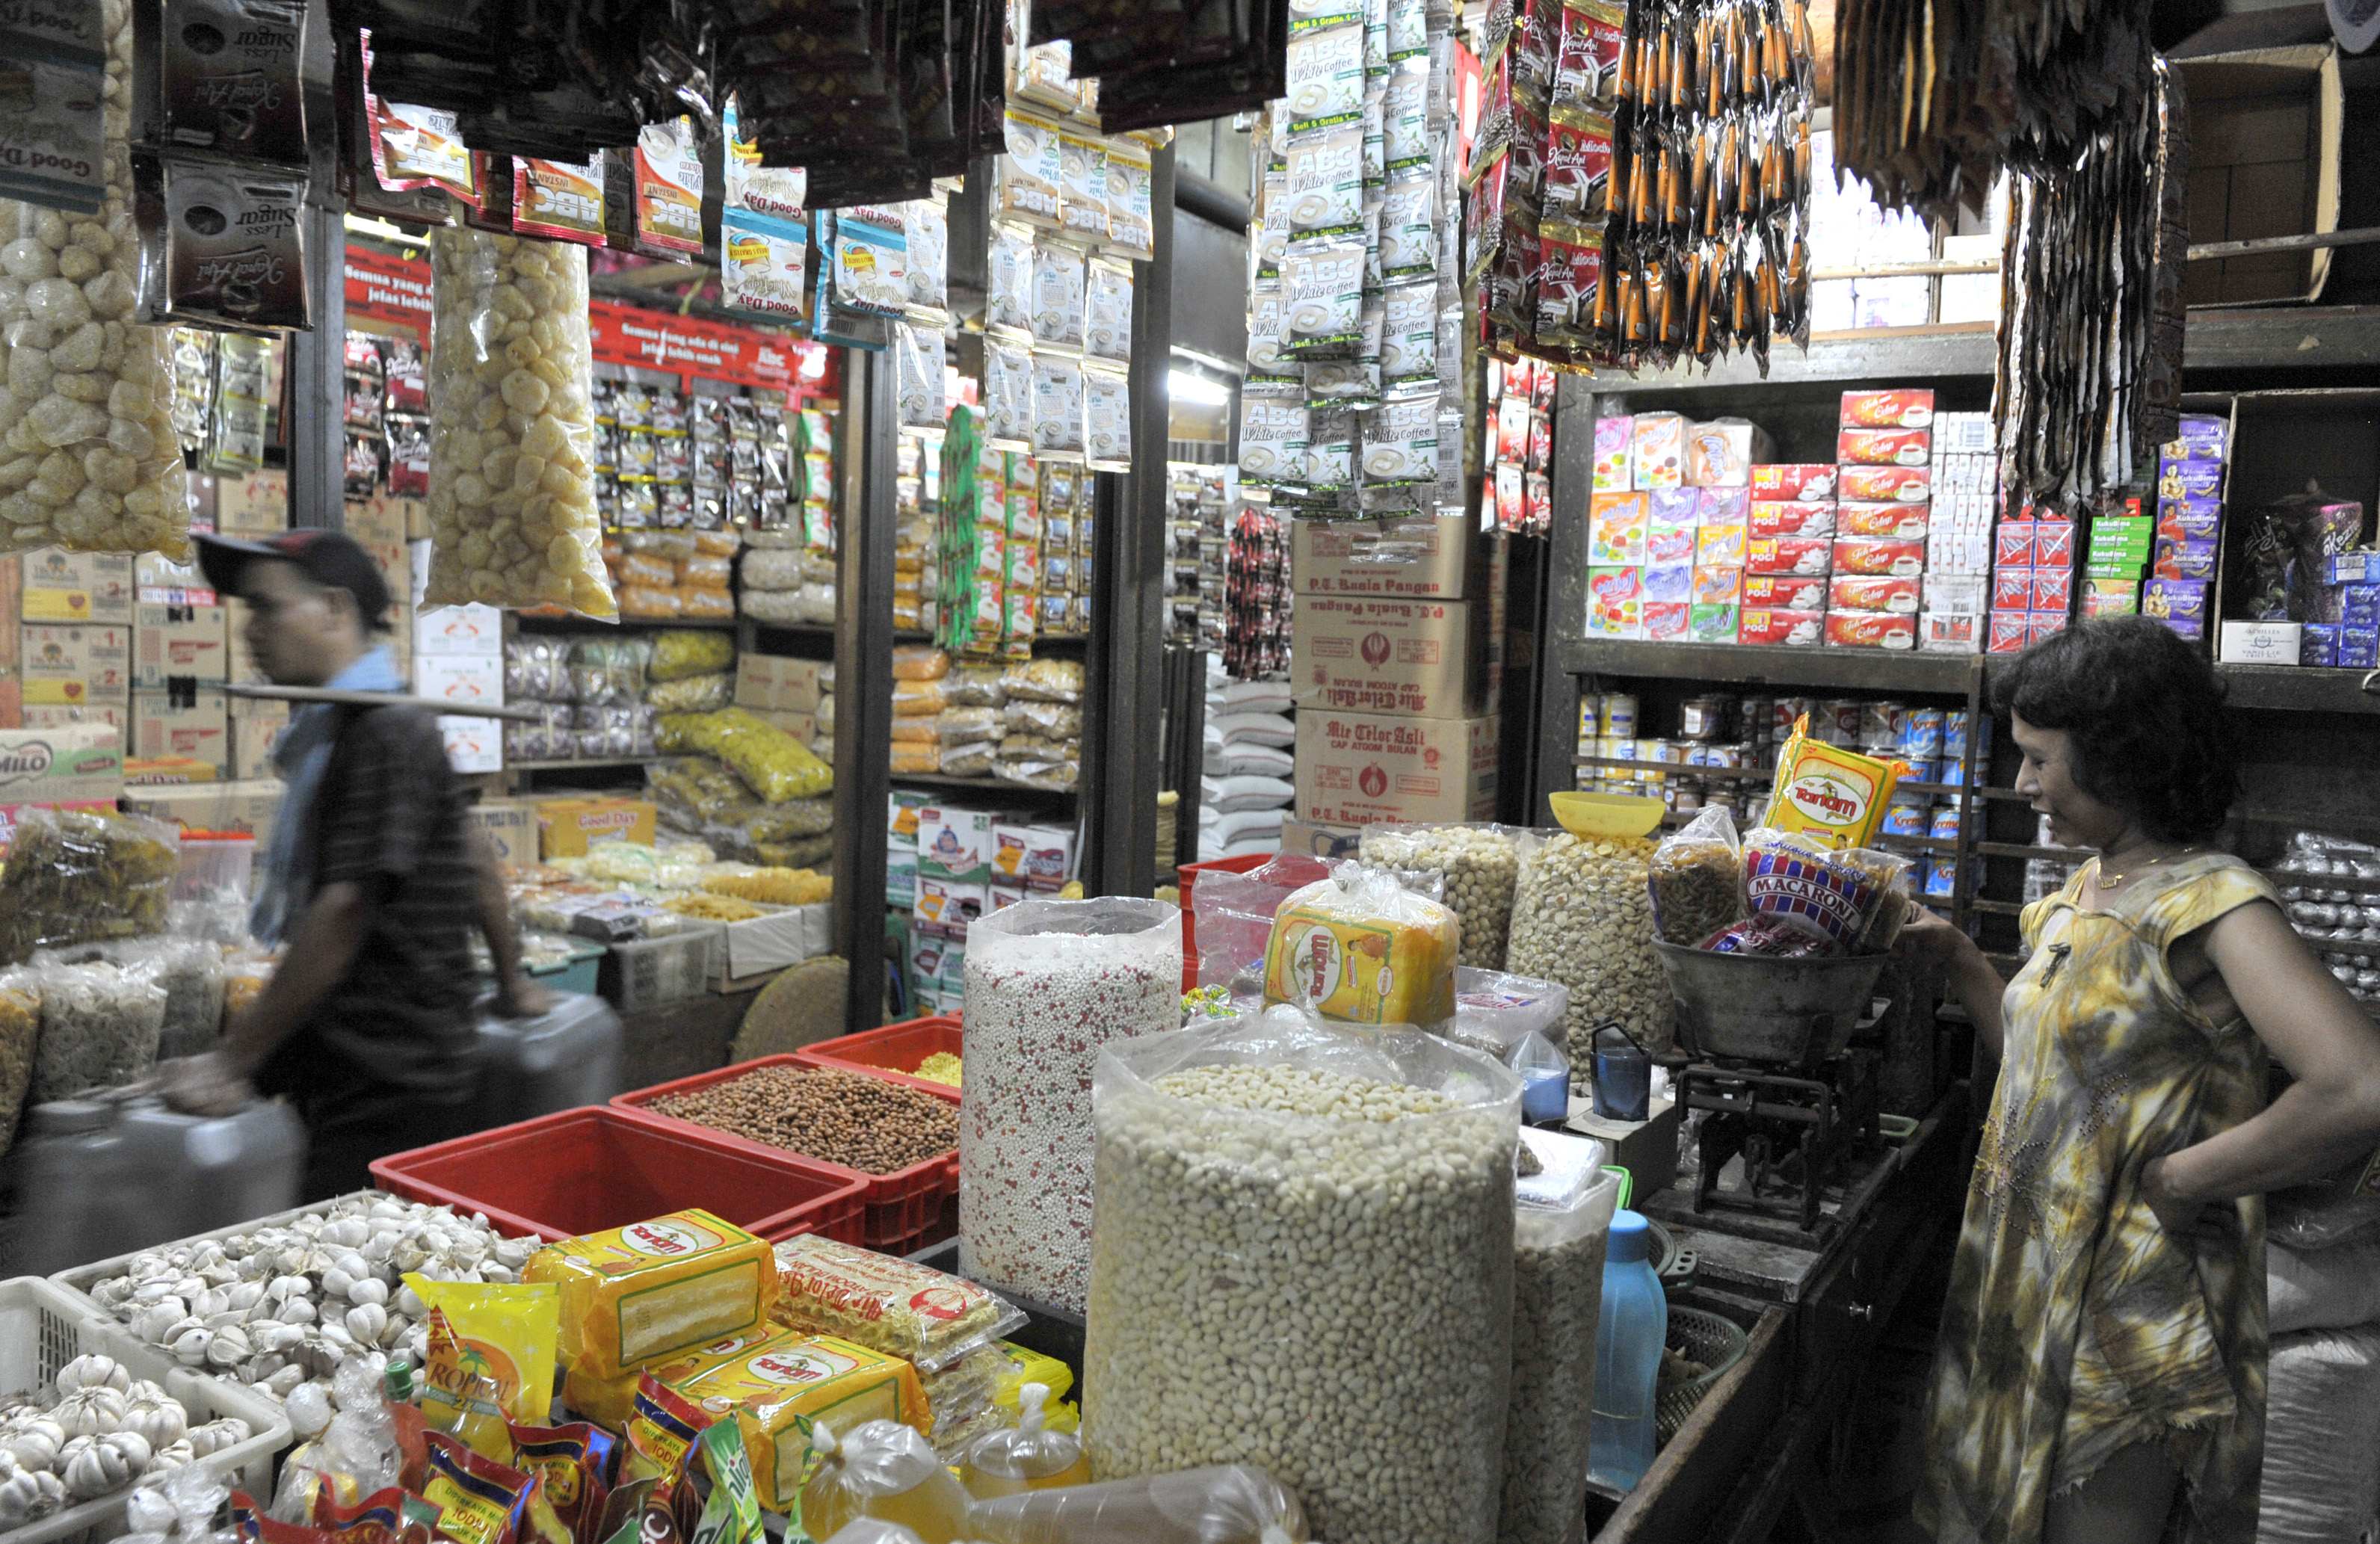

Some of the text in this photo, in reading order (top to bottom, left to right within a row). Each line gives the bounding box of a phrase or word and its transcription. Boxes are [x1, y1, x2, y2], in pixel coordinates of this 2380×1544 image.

[1293, 14, 1344, 30] Beli Gratis
[234, 25, 296, 52] Sugar
[1583, 38, 1598, 53] Api
[242, 48, 280, 64] Less
[1293, 33, 1355, 67] ABC
[1290, 62, 1324, 84] White
[1324, 57, 1354, 74] Coffee
[1293, 116, 1344, 132] Beli Gratis
[31, 150, 91, 178] Good
[1295, 145, 1354, 176] ABC
[1387, 158, 1411, 170] Gratis
[1570, 153, 1586, 167] Api
[531, 172, 569, 188] INSTANT
[1011, 177, 1037, 188] INSTANT
[1290, 168, 1353, 194] White Coffee
[647, 184, 679, 200] INSTANT
[1013, 187, 1058, 211] ABC
[534, 185, 602, 223] ABC
[742, 191, 802, 219] Good Day
[234, 204, 296, 226] Sugar
[650, 198, 701, 231] ABC
[853, 206, 902, 229] Good Day
[1065, 206, 1109, 231] ABC
[244, 224, 281, 238] Less
[1111, 223, 1150, 246] ABC
[1293, 226, 1344, 240] Beli Gratis
[1295, 258, 1354, 285] ABC
[1560, 265, 1576, 281] Api
[345, 264, 424, 297] Semua yang
[368, 285, 398, 305] jelas
[1289, 279, 1355, 302] White Coffee
[736, 293, 799, 316] Good Day
[852, 297, 904, 318] Good Day
[621, 322, 660, 340] Semua
[1396, 319, 1428, 335] Coffee
[1251, 374, 1266, 383] Beli
[1860, 395, 1878, 411] Teh
[1874, 402, 1899, 419] Celup
[1246, 404, 1303, 426] ABC
[1366, 406, 1431, 427] ABC
[1242, 427, 1303, 442] White Coffee
[1318, 433, 1345, 444] Coffee
[1364, 427, 1431, 445] White Coffee
[1857, 434, 1874, 449] Teh
[2180, 434, 2222, 442] KukuBima
[1869, 439, 1895, 457] Celup
[1754, 481, 1781, 490] POCI
[1858, 472, 1875, 487] Teh
[1869, 477, 1896, 494] Celup
[1753, 516, 1780, 526] POCI
[1855, 510, 1873, 525] Teh
[1869, 514, 1893, 531] Celup
[1750, 552, 1776, 562] POCI
[1851, 546, 1869, 561] Teh
[1863, 551, 1890, 568] Celup
[1385, 578, 1440, 594] Pangan
[1746, 588, 1772, 598] POCI
[1847, 583, 1865, 596] Teh
[1860, 587, 1886, 603] Celup
[2162, 594, 2203, 602] KukuBima
[1743, 623, 1769, 633] POCI
[1843, 618, 1860, 632] Teh
[1855, 625, 1881, 639] Celup
[1333, 678, 1420, 693] CAP ATOOM BULAN
[1325, 720, 1426, 746] Mie Telor Asli
[1331, 740, 1418, 756] CAP ATOOM BULAN
[1794, 785, 1857, 818] Tanam
[1893, 815, 1926, 827] Krem
[1937, 867, 1955, 879] Kre
[1755, 878, 1857, 923] MACARONI
[1310, 934, 1329, 998] Tanam
[629, 1225, 687, 1254] Tanam
[755, 1357, 824, 1381] Tanam
[450, 1395, 475, 1414] 2x
[643, 1425, 681, 1454] DIPERKAYA
[652, 1445, 675, 1465] IODI
[444, 1488, 487, 1515] DIPERKAYA
